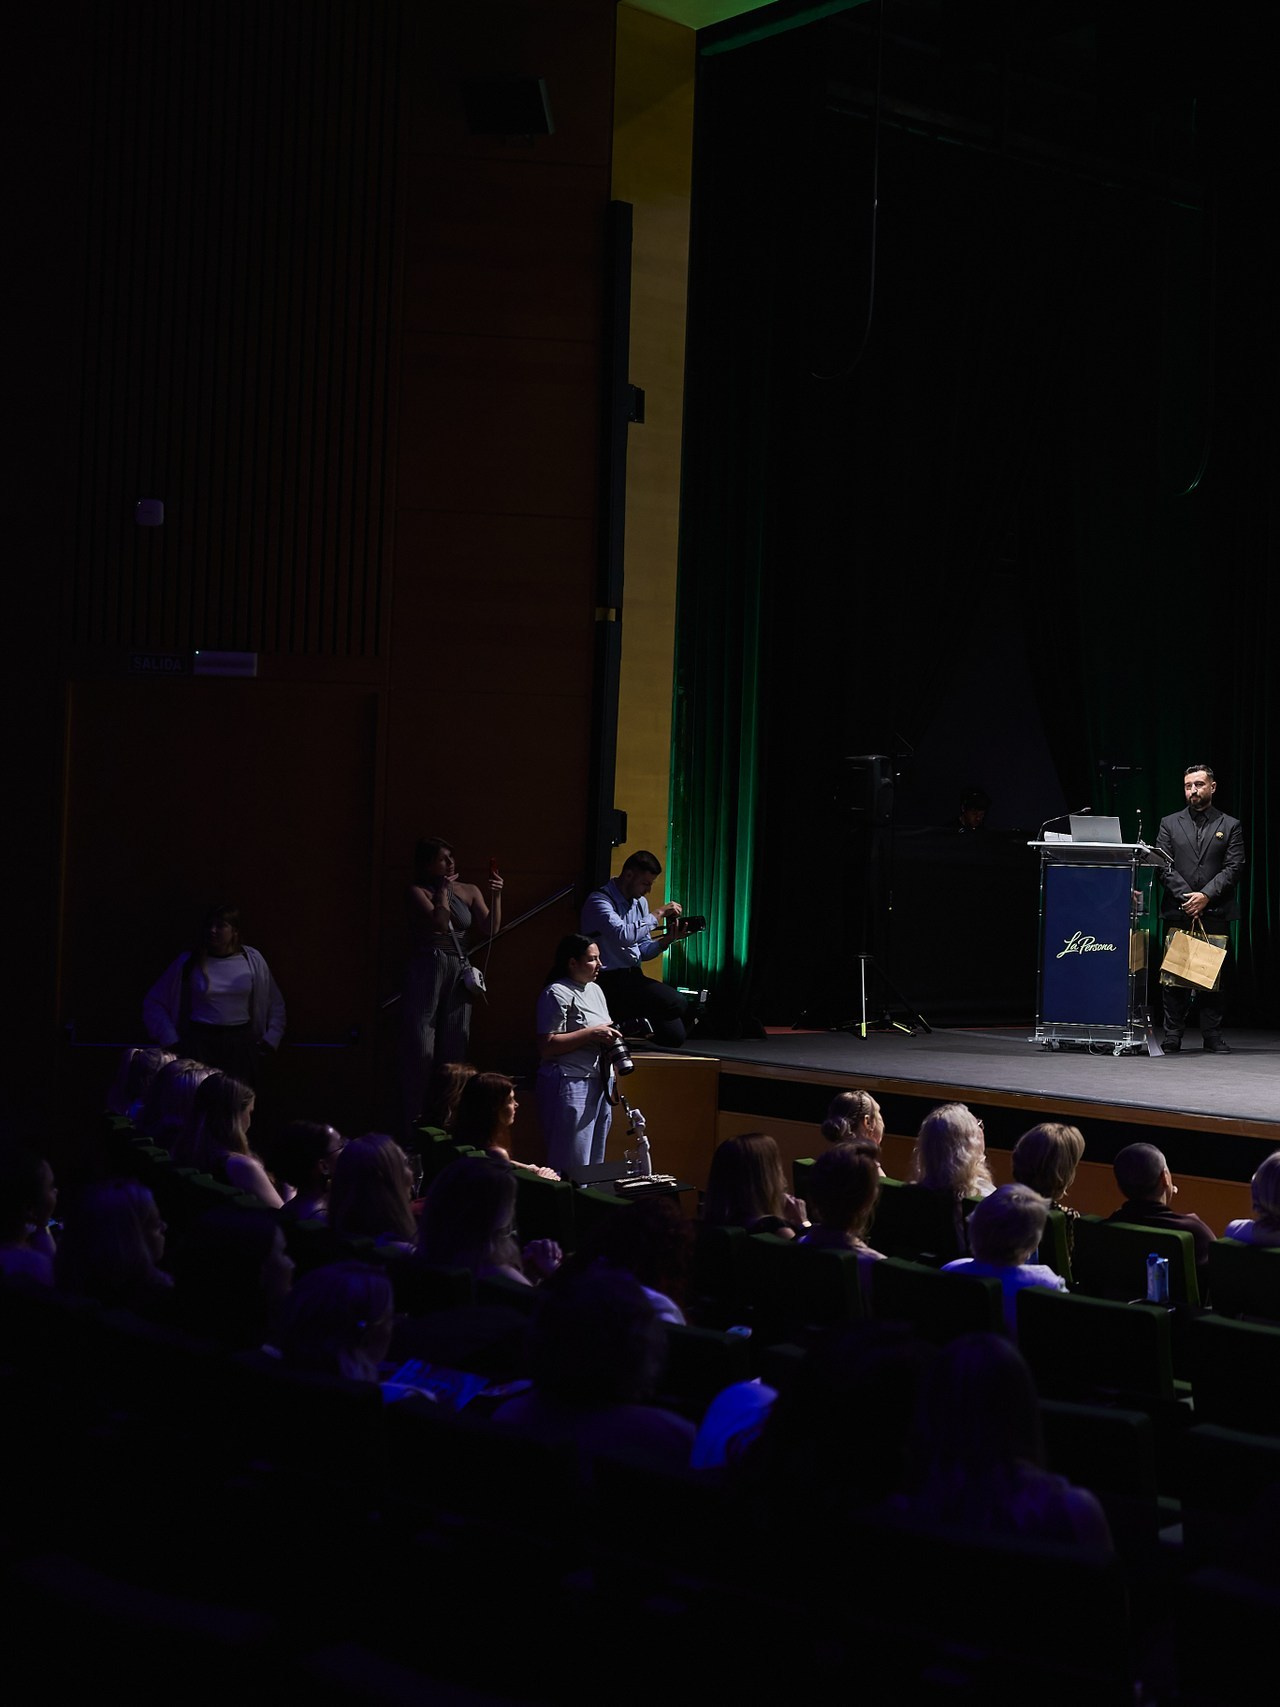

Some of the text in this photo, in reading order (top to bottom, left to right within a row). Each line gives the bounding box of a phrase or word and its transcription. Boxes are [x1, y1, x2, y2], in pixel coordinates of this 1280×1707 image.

[132, 656, 182, 672] SALIDA
[1056, 930, 1117, 958] La Persona
